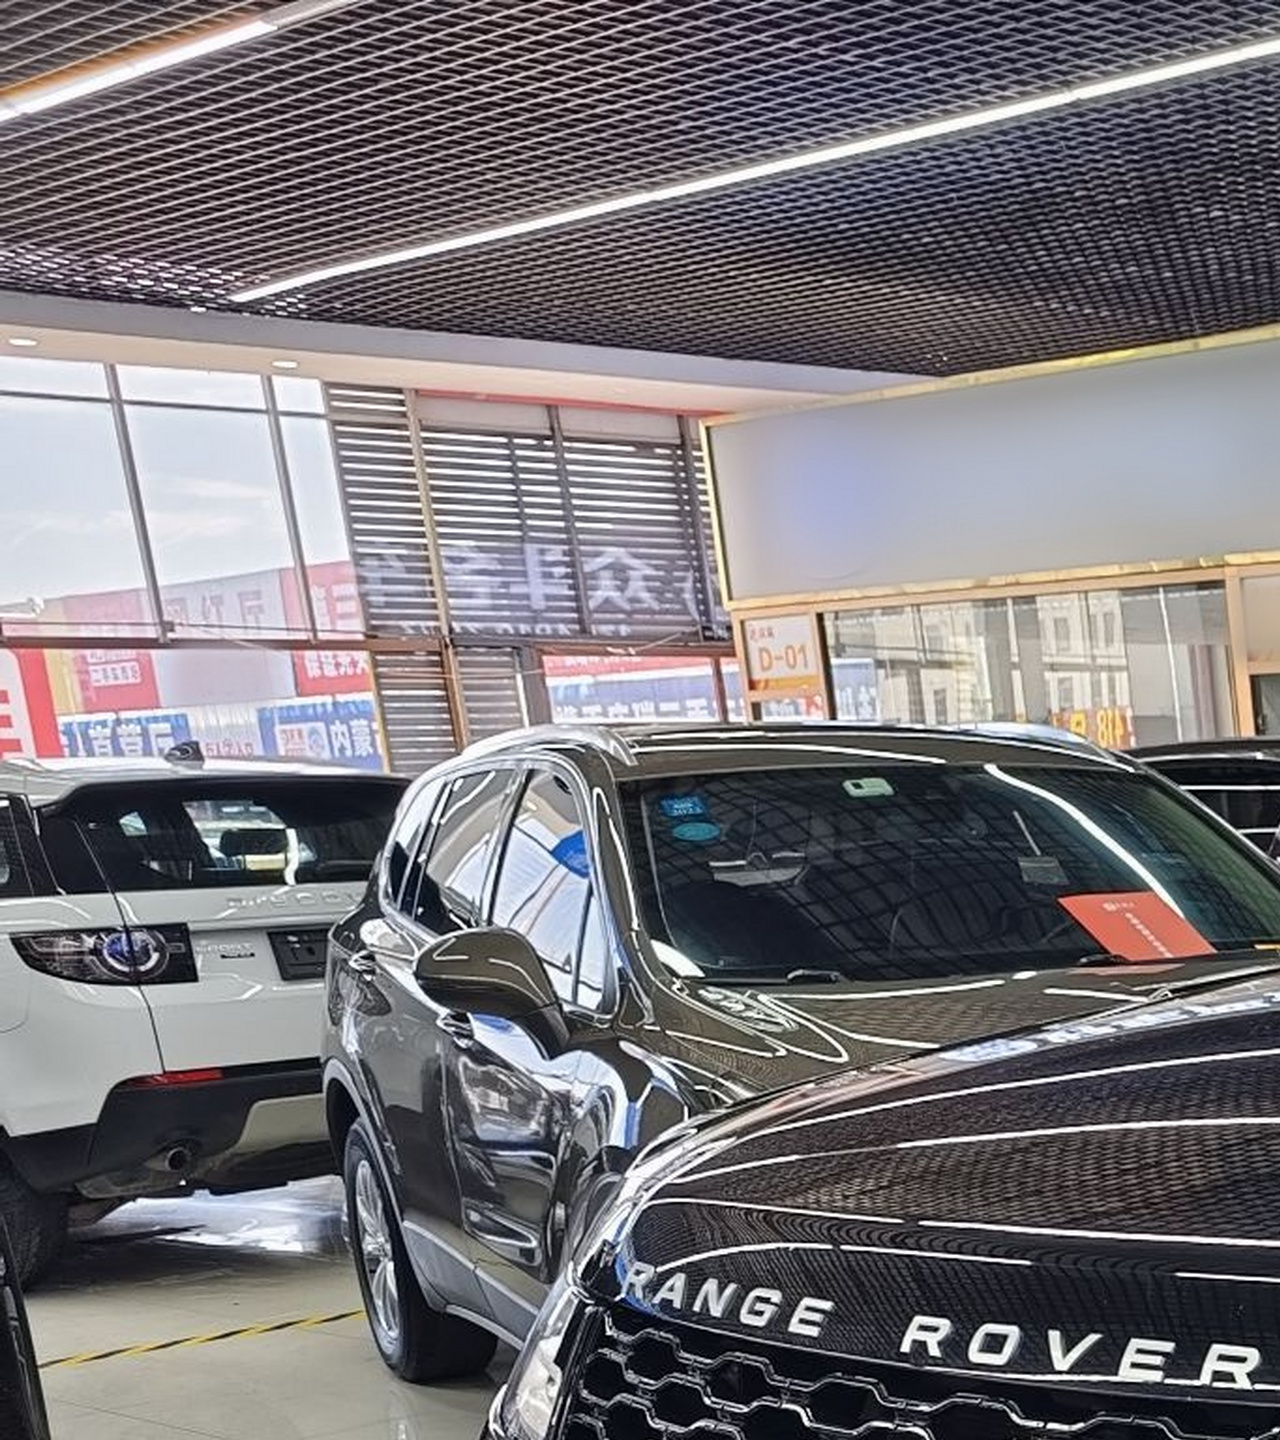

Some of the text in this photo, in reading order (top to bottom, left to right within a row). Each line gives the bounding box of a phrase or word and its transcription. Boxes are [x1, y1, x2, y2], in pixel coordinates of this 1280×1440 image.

[758, 643, 809, 672] D-01
[620, 1261, 1262, 1389] RANGE ROVER
